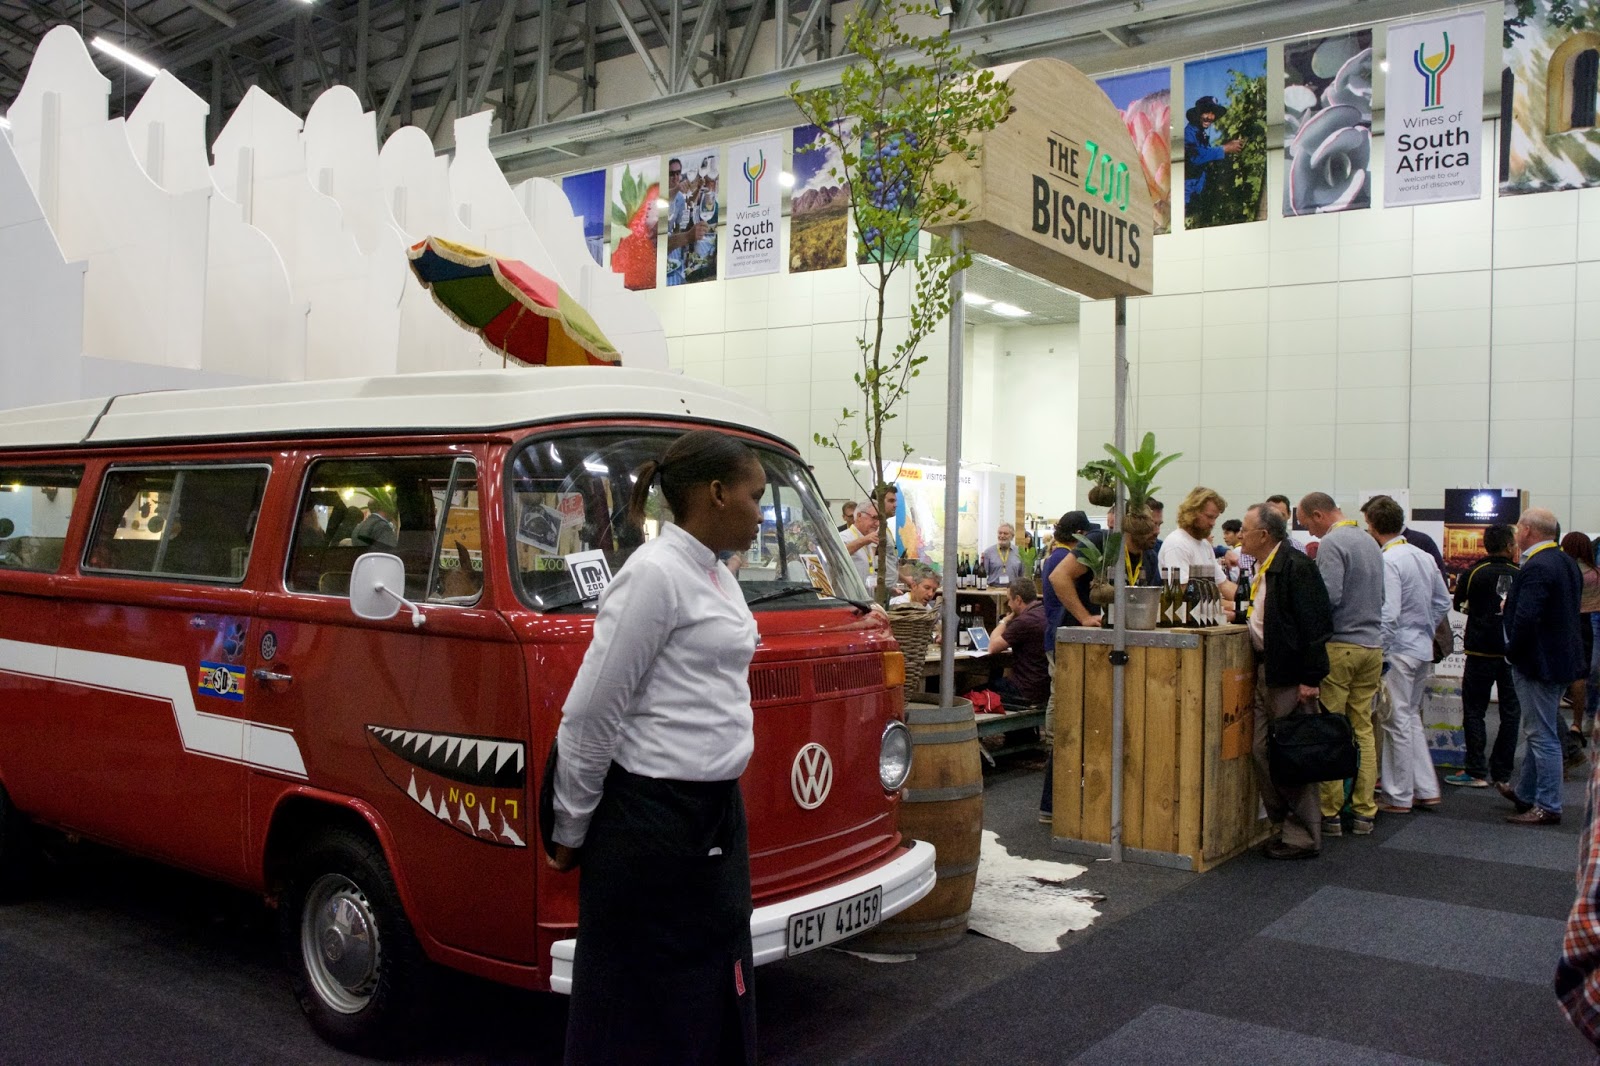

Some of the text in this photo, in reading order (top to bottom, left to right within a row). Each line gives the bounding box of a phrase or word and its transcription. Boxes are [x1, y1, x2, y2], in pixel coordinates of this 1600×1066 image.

[1403, 111, 1463, 129] Wines of
[1398, 127, 1469, 152] South
[1396, 151, 1469, 174] Africa
[1047, 136, 1130, 213] THE ZOO
[1403, 174, 1436, 183] welcome
[1398, 180, 1466, 192] world of discovery
[735, 207, 770, 220] Wines of
[1032, 173, 1140, 269] BISCUITS
[733, 219, 774, 237] South
[732, 237, 774, 254] Africa
[900, 469, 919, 479] DHL
[586, 582, 604, 591] ZOO
[793, 744, 832, 807] VW
[793, 893, 879, 949] CEY 41159
